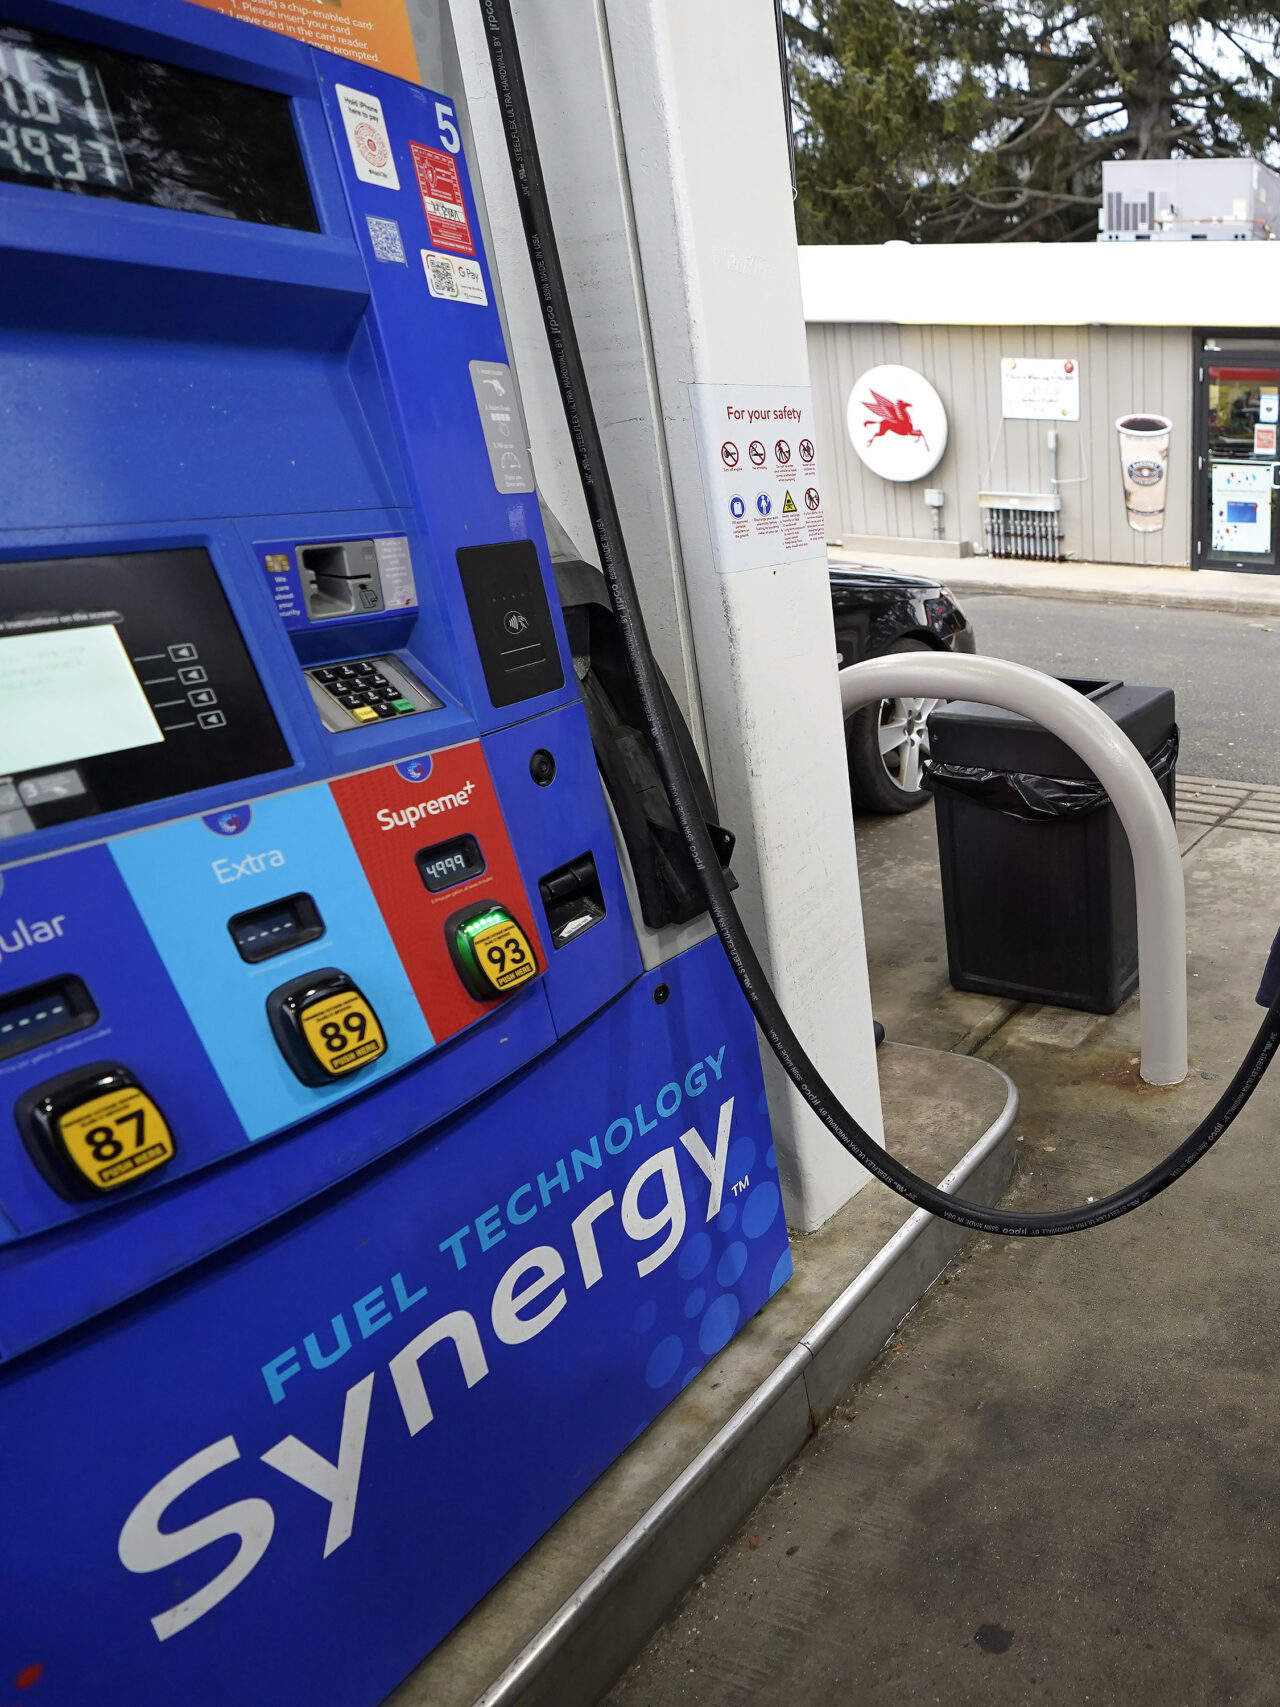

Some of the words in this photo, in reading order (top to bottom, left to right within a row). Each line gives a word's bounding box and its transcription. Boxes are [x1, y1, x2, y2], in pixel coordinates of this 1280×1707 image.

[241, 2, 275, 18] Please
[277, 12, 305, 25] insert
[305, 19, 329, 31] your
[330, 24, 353, 36] card.
[280, 2, 286, 10] a
[287, 2, 351, 25] chip-enabled
[352, 19, 375, 31] card:
[229, 10, 261, 26] Leave
[262, 18, 284, 30] card
[286, 24, 296, 33] in
[298, 26, 314, 38] the
[315, 31, 337, 43] card
[338, 36, 369, 49] reader.
[494, 37, 502, 46] BY
[333, 44, 381, 63] prompted.
[498, 48, 511, 91] HARDWALL
[344, 96, 359, 107] Hold
[505, 92, 514, 119] ULTRA
[348, 106, 361, 117] here
[369, 114, 379, 124] pay
[435, 101, 461, 154] 5
[510, 119, 523, 162] STEELFLEX
[531, 234, 541, 250] USA
[536, 251, 542, 260] IN
[466, 268, 479, 282] Pay
[537, 260, 547, 283] MADE
[555, 338, 563, 349] BY
[557, 349, 572, 389] HARDWALL
[567, 389, 577, 414] ULTRA
[727, 406, 745, 420] For
[748, 409, 771, 424] your
[773, 405, 802, 423] safety
[571, 414, 588, 452] STEELFLEX
[597, 518, 605, 530] USA
[603, 543, 614, 566] MADE
[275, 593, 294, 601] about
[6, 615, 59, 629] instructions
[60, 615, 72, 623] on
[72, 612, 88, 622] the
[677, 805, 687, 823] MADE
[211, 849, 286, 884] Extra
[0, 914, 66, 955] ular
[487, 938, 526, 973] 93
[726, 936, 746, 974] STEELFLEX
[498, 971, 515, 986] PUSH
[515, 964, 533, 978] HERE
[320, 1012, 368, 1053] 89
[769, 1028, 779, 1043] USA
[333, 1052, 355, 1068] PUSH
[356, 1043, 379, 1059] HERE
[776, 1041, 782, 1049] IN
[781, 1049, 793, 1068] MADE
[1251, 1053, 1268, 1078] STEELFLEX
[1242, 1077, 1253, 1093] ULTRA
[819, 1107, 827, 1116] BY
[85, 1108, 145, 1162] 87
[826, 1115, 850, 1144] HARDWALL
[849, 1143, 866, 1160] ULTRA
[865, 1157, 894, 1183] STEELFLEX
[261, 1272, 428, 1404] FUEL
[439, 1046, 727, 1271] TECHNOLOGY
[944, 1210, 957, 1221] USA
[964, 1218, 983, 1229] MADE
[1074, 1218, 1095, 1230] ULTRA
[1041, 1223, 1075, 1235] HARDWALL
[117, 1096, 735, 1642] Synergy
[731, 1174, 750, 1199] TM
